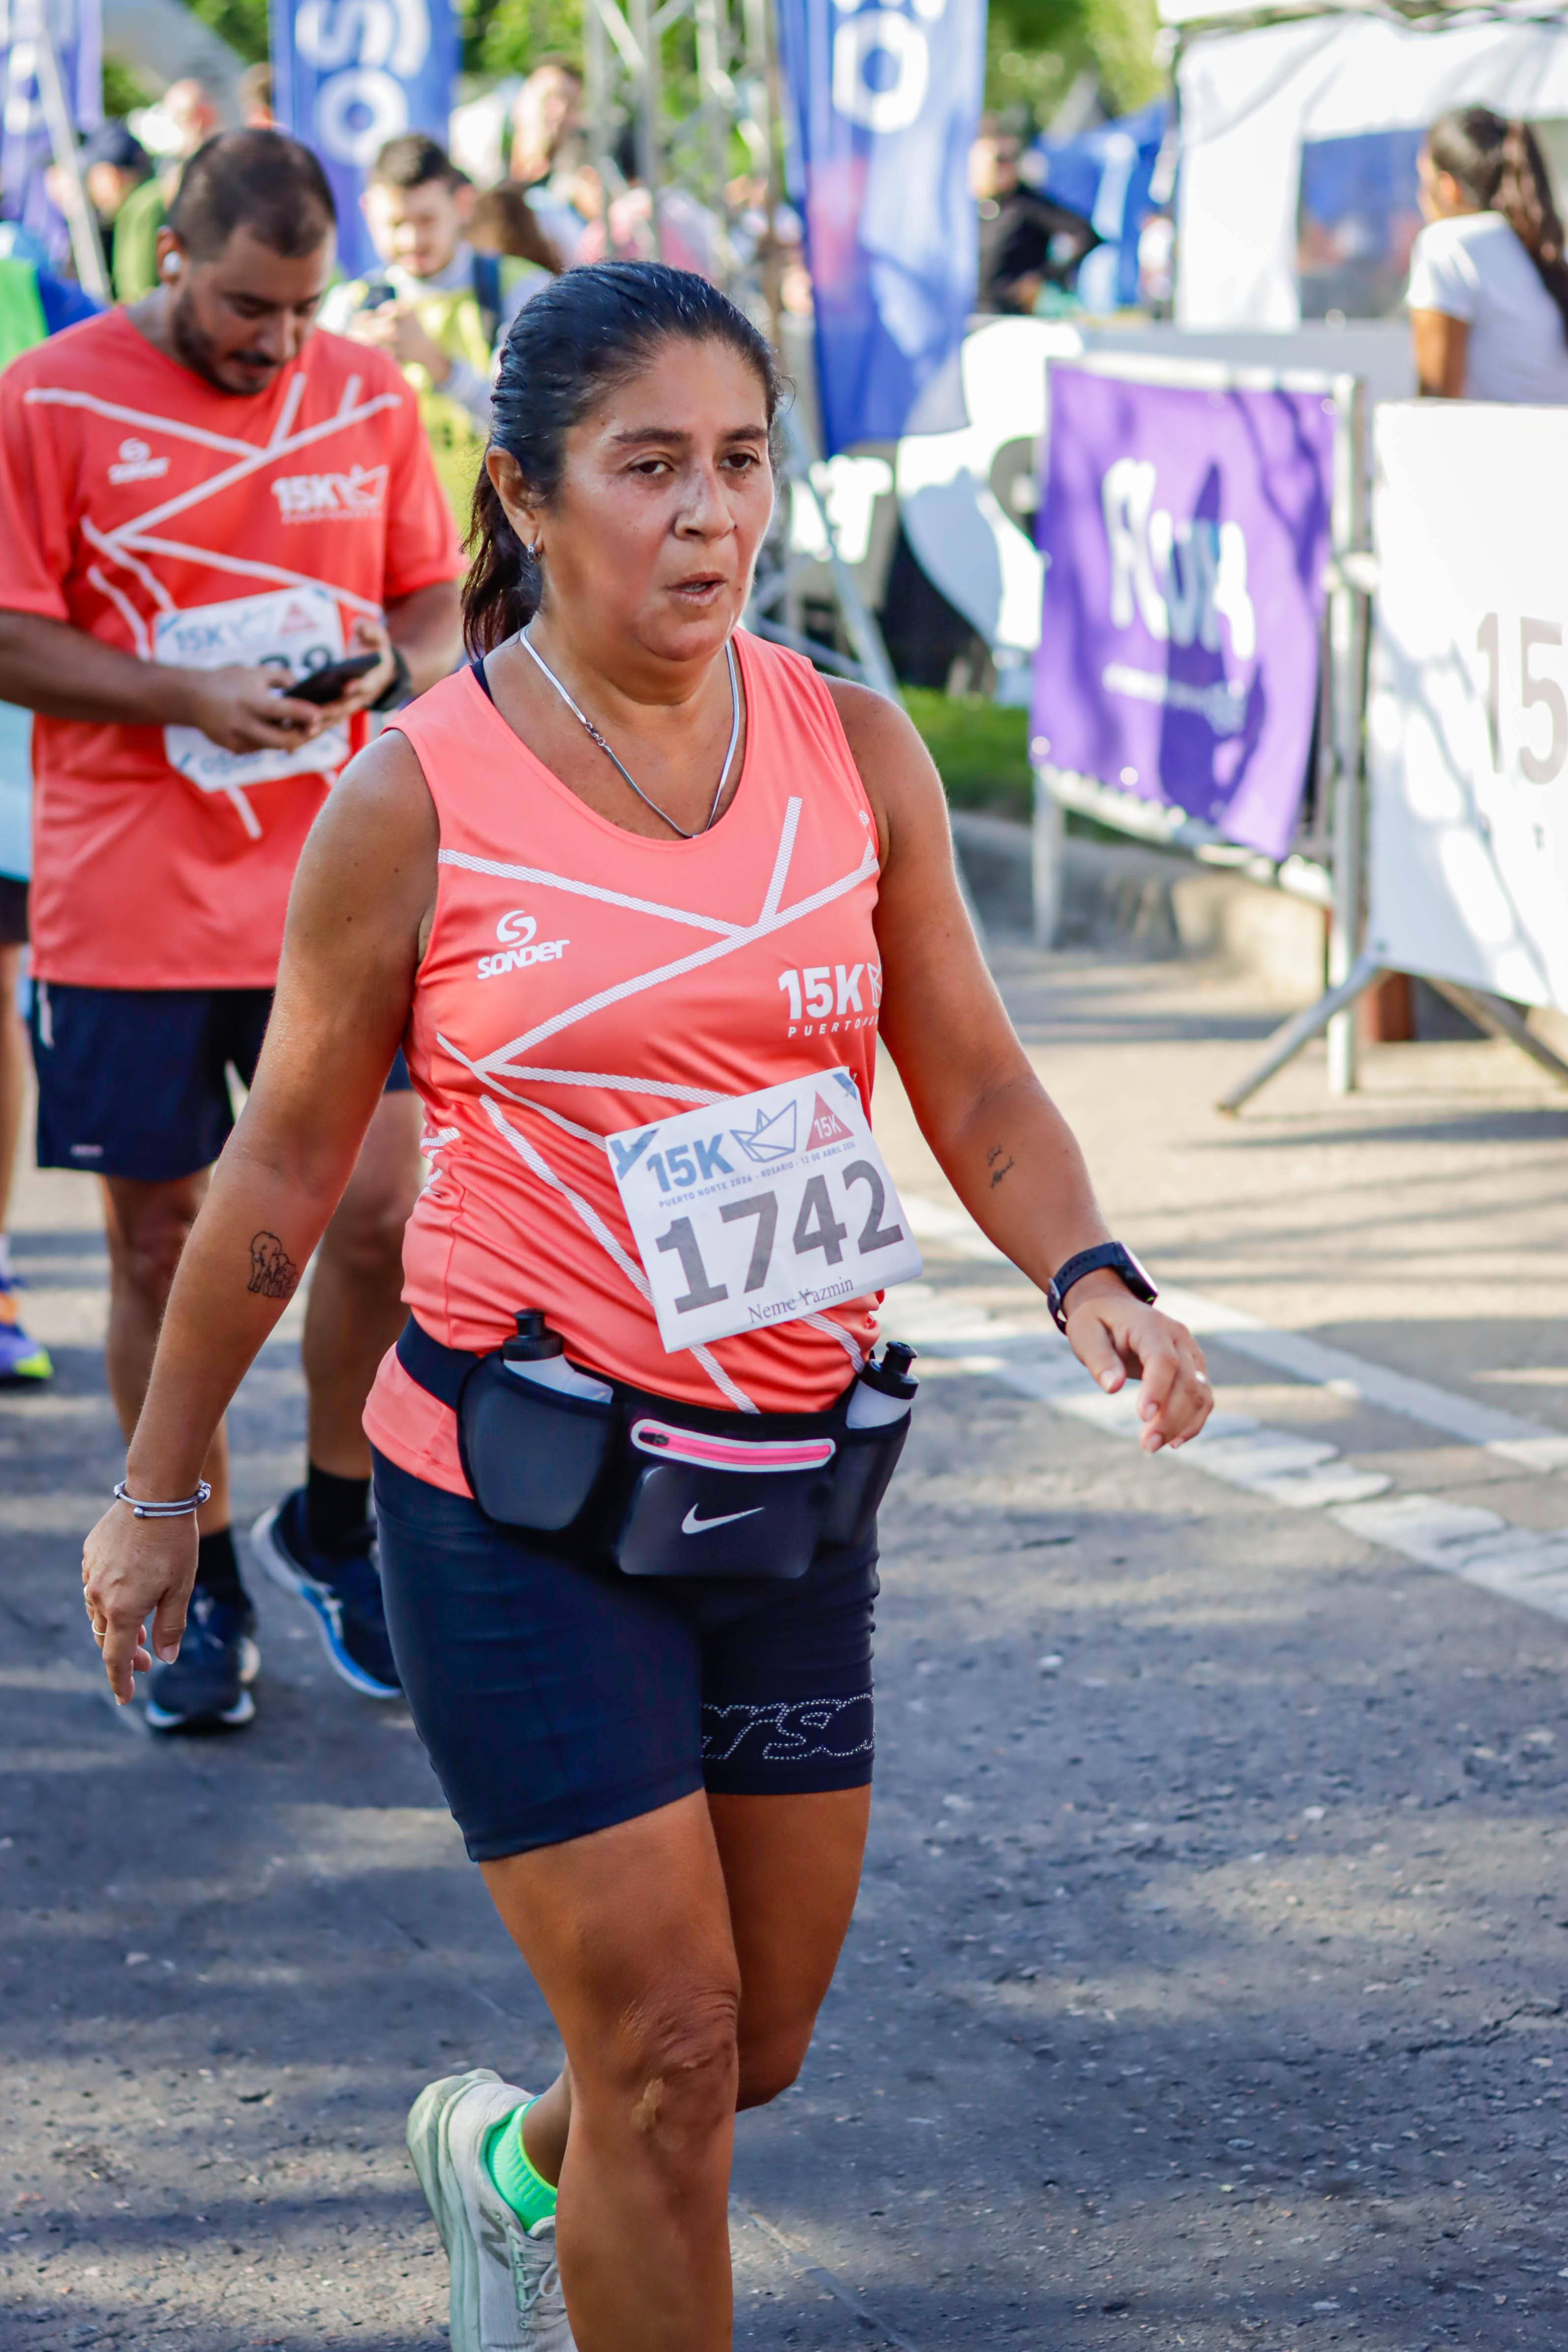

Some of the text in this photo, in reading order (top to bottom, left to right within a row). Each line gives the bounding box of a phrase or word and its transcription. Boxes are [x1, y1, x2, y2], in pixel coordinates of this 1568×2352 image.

[778, 964, 864, 1020] 15K
[646, 1113, 842, 1193] 15K 15K
[658, 1191, 695, 1207] PUERTO
[697, 1182, 727, 1197] NORTE
[761, 1161, 794, 1177] ROSARIO
[801, 1155, 810, 1165] 12
[811, 1151, 821, 1162] DE
[823, 1145, 842, 1158] ABRIL
[655, 1160, 904, 1315] 1742
[747, 1276, 854, 1323] Neme Yazmin
